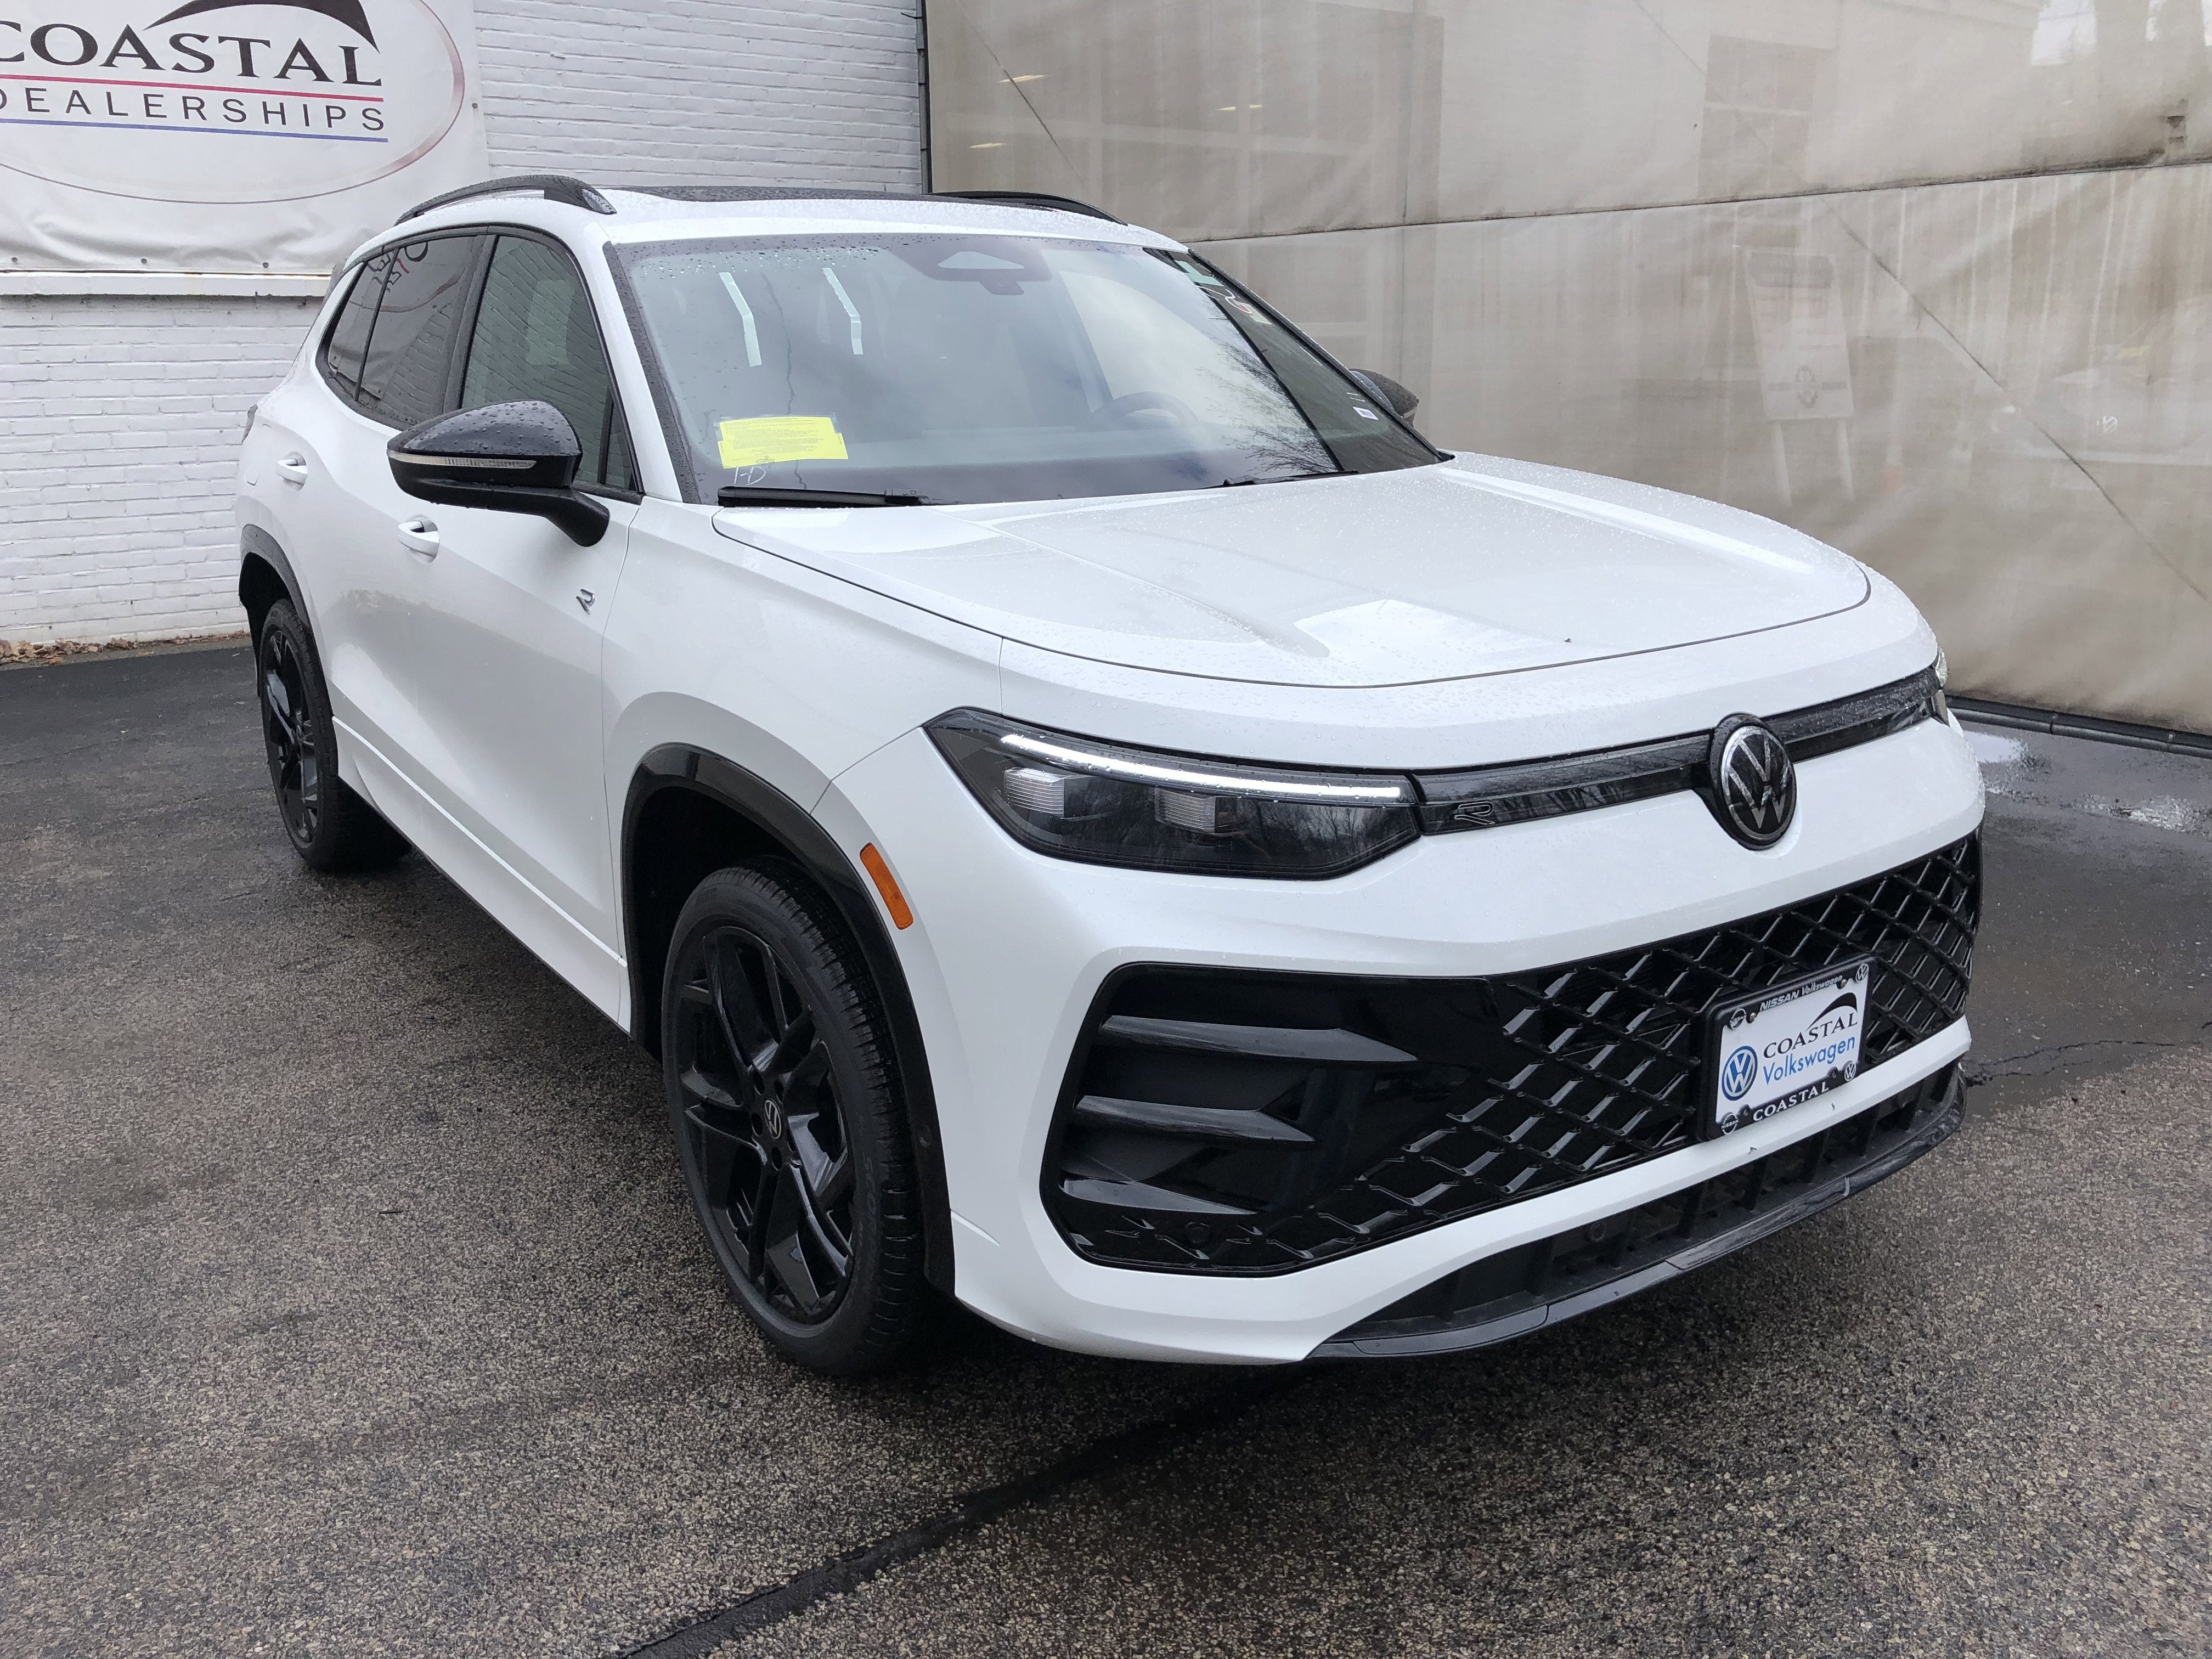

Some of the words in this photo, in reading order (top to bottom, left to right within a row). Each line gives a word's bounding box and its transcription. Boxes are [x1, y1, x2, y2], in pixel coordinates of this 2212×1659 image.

[0, 87, 385, 132] EALERSHIPS
[1759, 990, 1800, 1012] NISSAN
[1802, 975, 1843, 996] Volkswagen
[1763, 1013, 1858, 1058] COASTAL
[1763, 1036, 1856, 1085] Volkswagen
[1753, 1081, 1829, 1122] COASTAL
